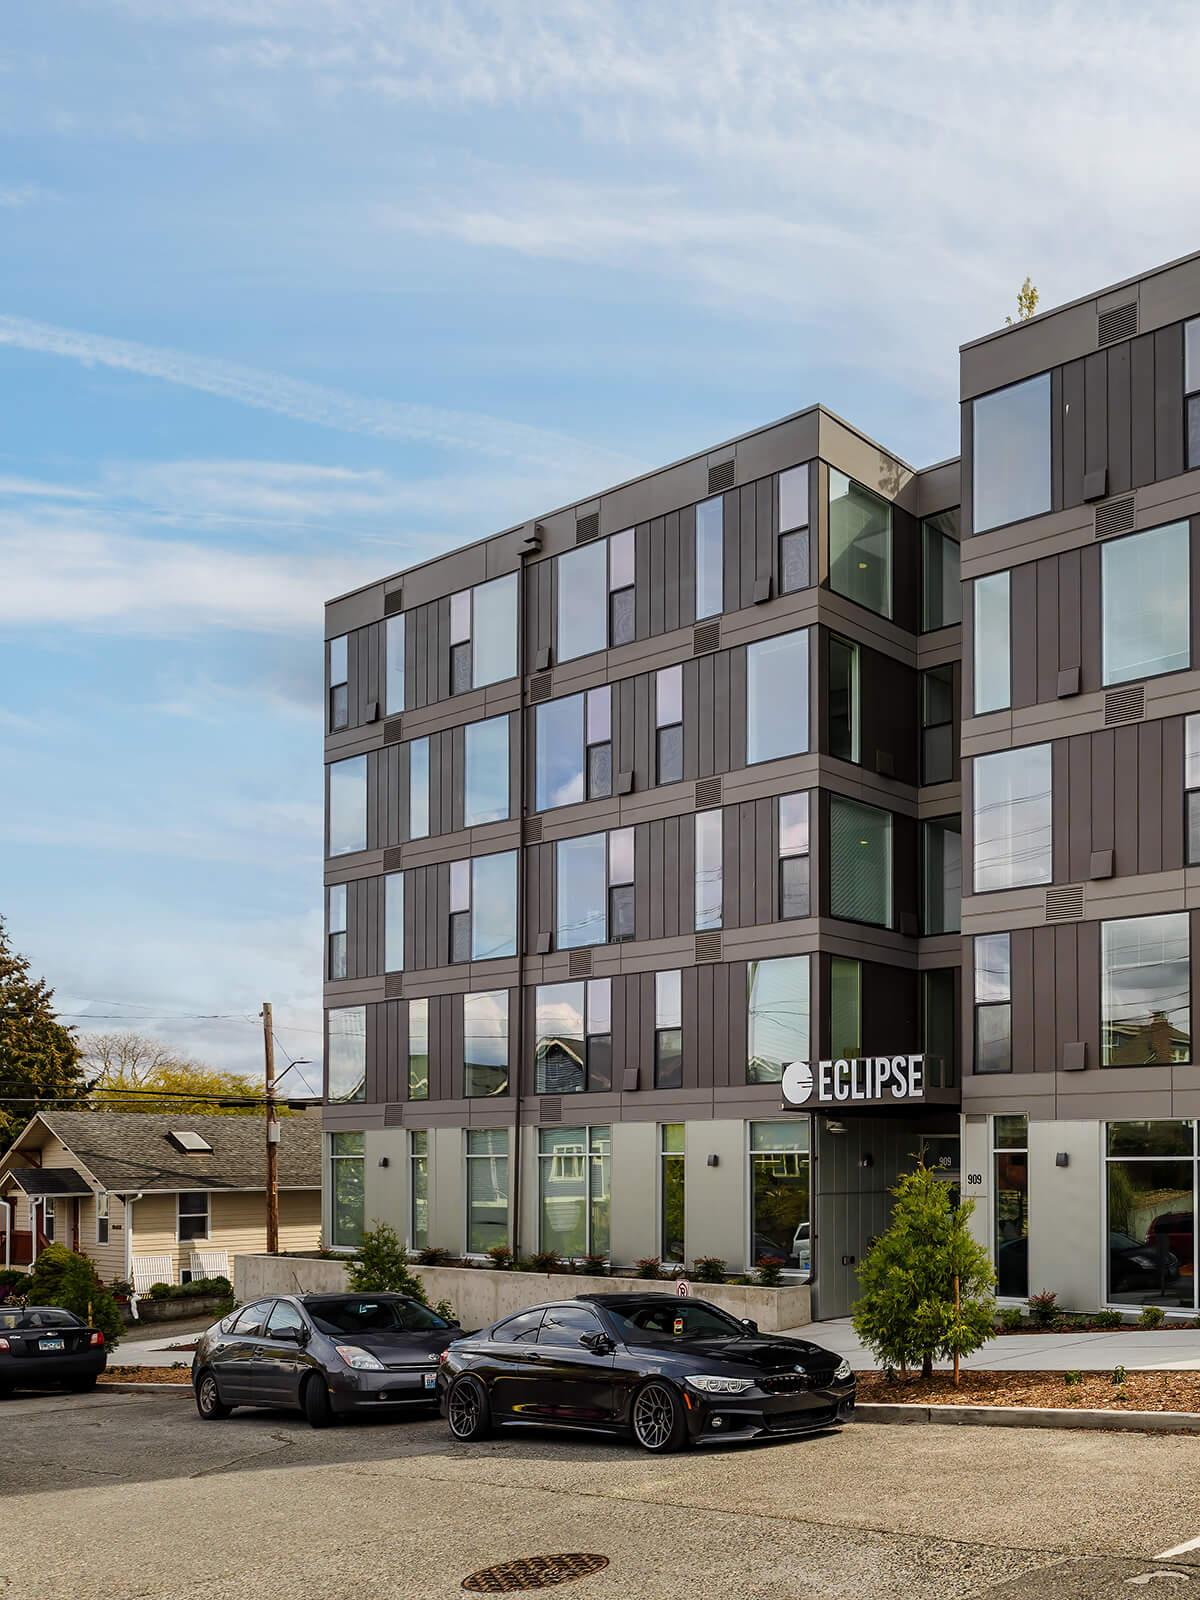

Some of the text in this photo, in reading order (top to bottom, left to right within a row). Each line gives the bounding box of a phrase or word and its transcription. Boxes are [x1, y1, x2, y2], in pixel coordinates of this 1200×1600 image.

[818, 1055, 924, 1101] ECLIPSE
[939, 1157, 952, 1166] 909
[967, 1174, 982, 1185] 909
